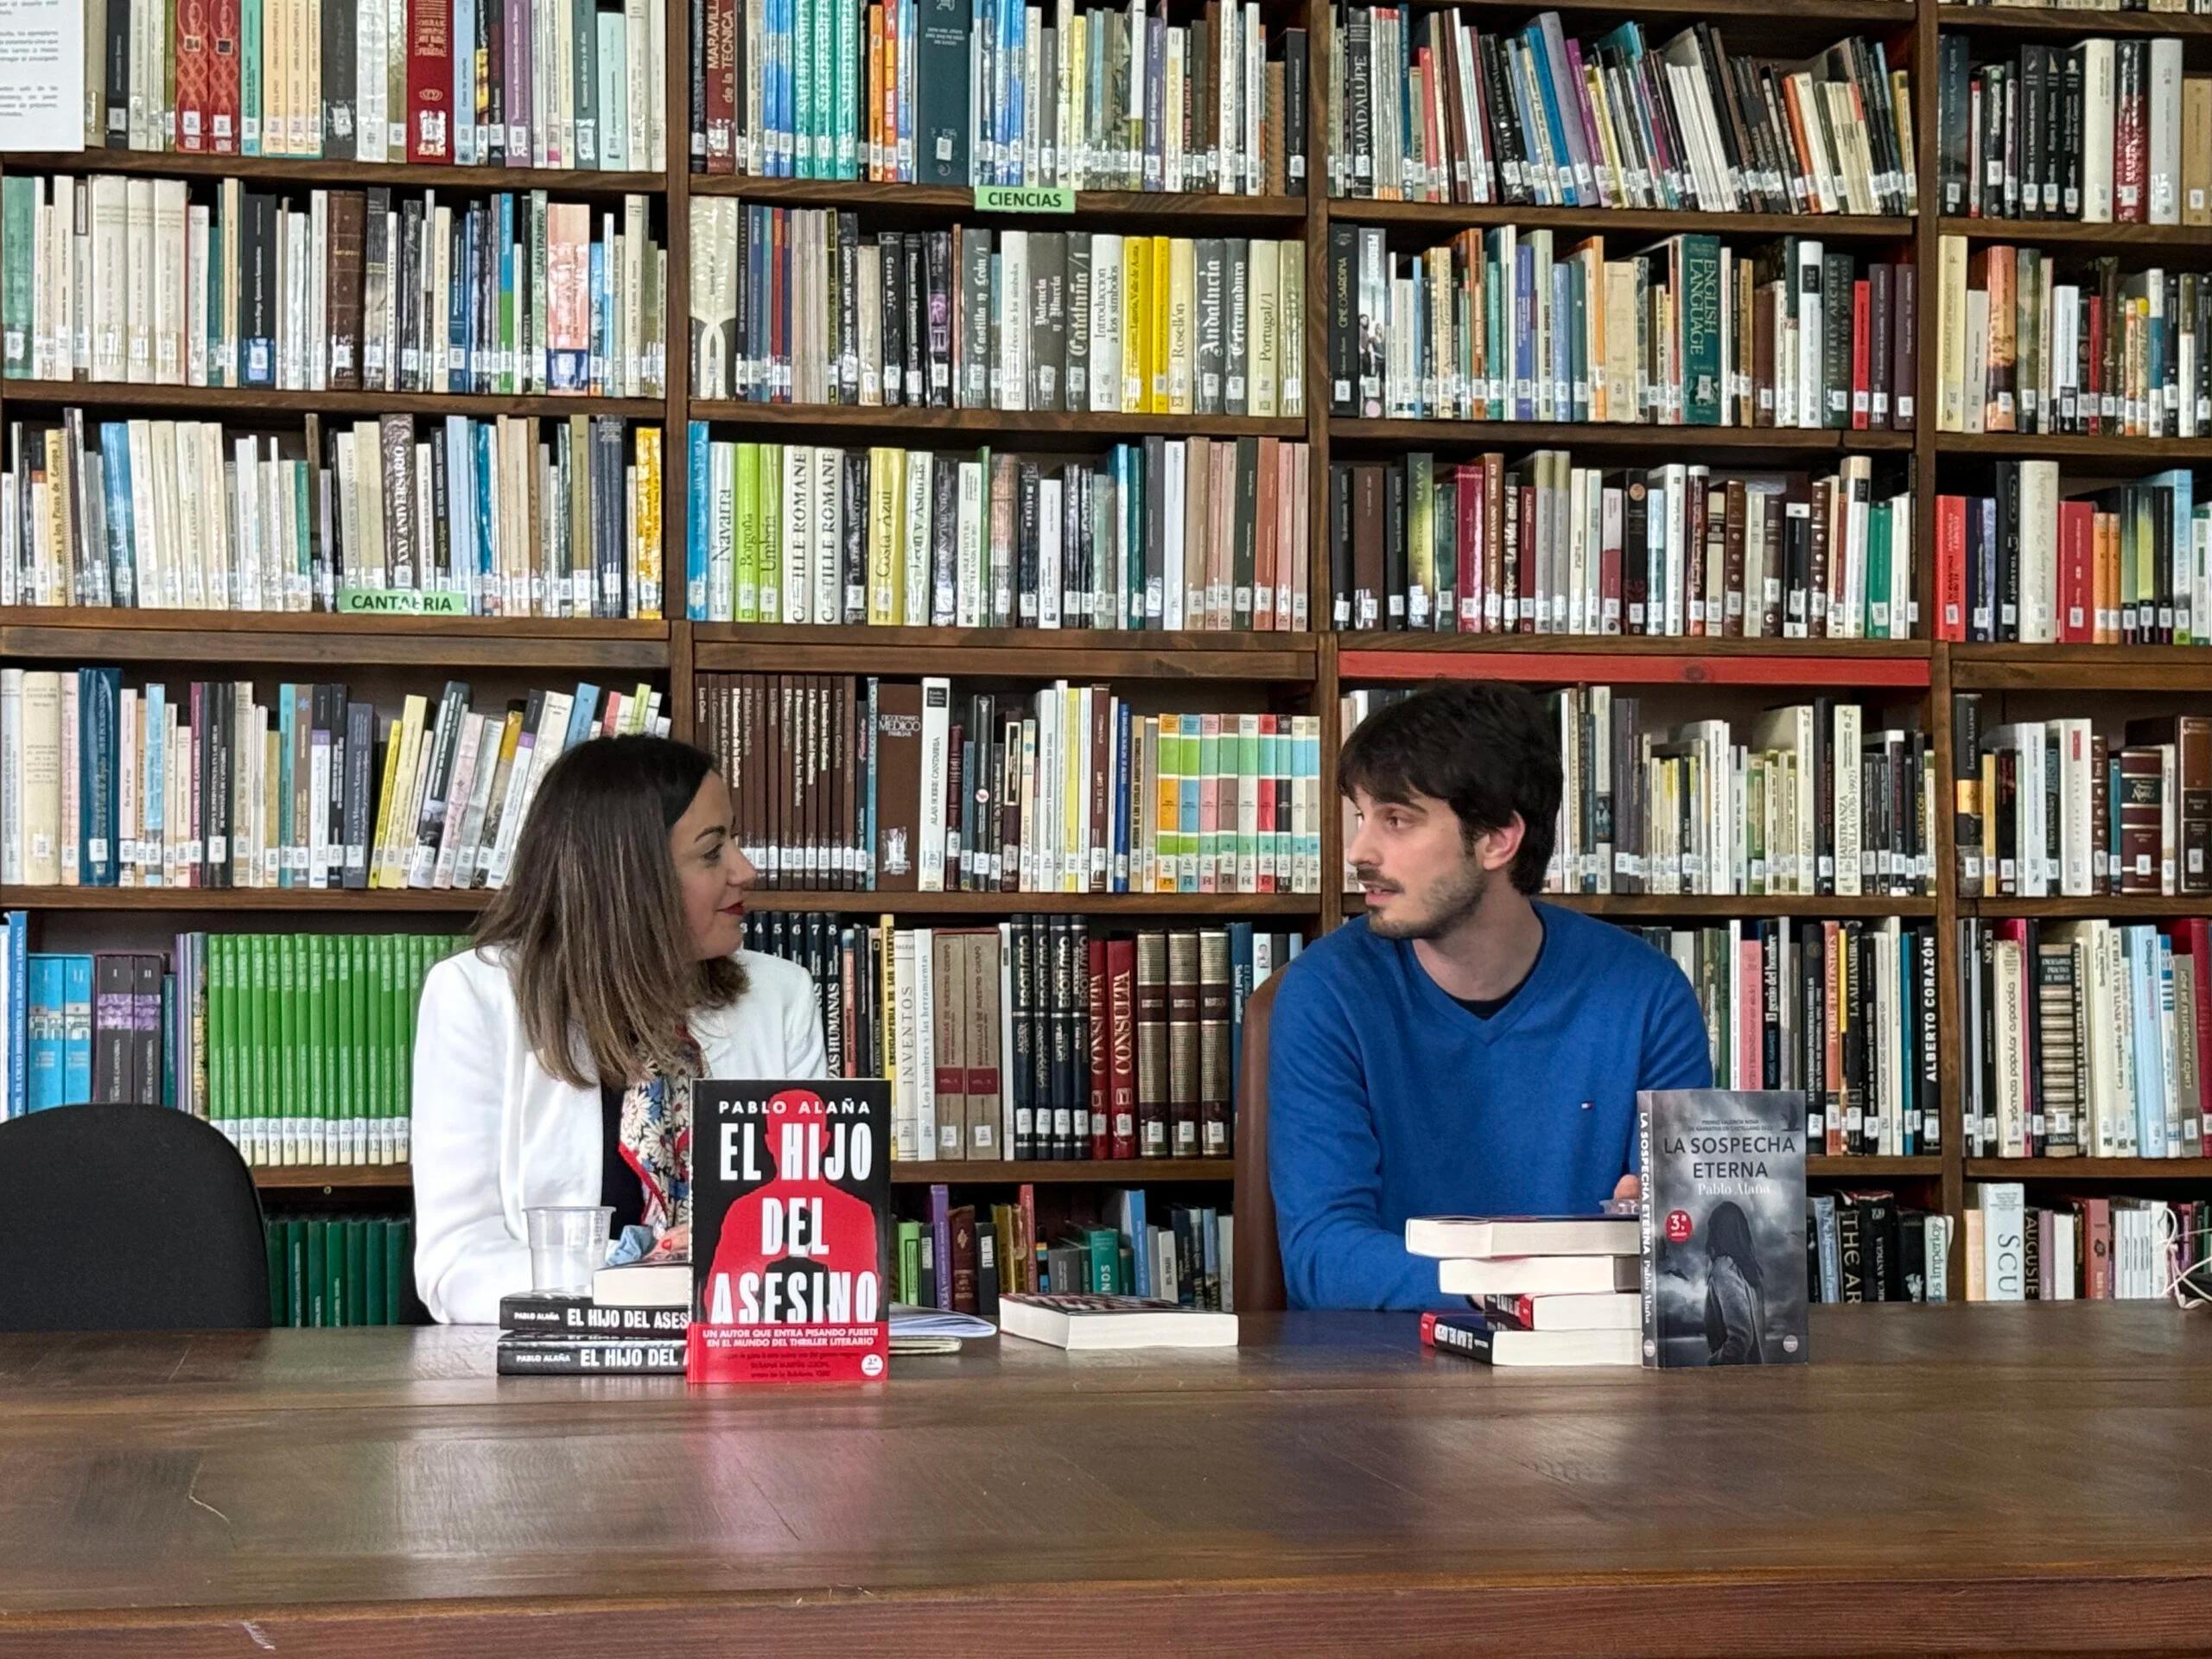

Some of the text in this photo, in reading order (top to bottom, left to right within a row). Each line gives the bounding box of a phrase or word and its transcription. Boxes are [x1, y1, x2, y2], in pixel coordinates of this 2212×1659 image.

[721, 10, 734, 103] de la TECNICA
[1353, 55, 1369, 156] GUADALUPE
[987, 191, 1063, 208] CIENCIAS
[887, 257, 895, 307] Greek Art
[910, 283, 918, 298] and
[1050, 276, 1063, 316] Murcia
[1338, 257, 1348, 297] SARDINA
[1704, 259, 1717, 334] ENGLISH
[1034, 279, 1049, 326] Valencia
[1094, 268, 1109, 339] Introducción
[1107, 316, 1120, 333] los
[1199, 260, 1223, 356] Andalucía
[1230, 262, 1245, 356] Extremadura
[1338, 307, 1348, 327] CINE
[1689, 258, 1703, 354] LANGUAGE
[1827, 260, 1838, 380] JEFFREY ARCHER
[973, 307, 988, 354] Castilla
[1171, 303, 1186, 358] Rosellón
[50, 449, 60, 493] de Europa
[393, 447, 408, 535] ANIVERSARIO
[1414, 461, 1424, 500] MAYA
[52, 497, 60, 518] Picos
[711, 489, 732, 563] Navarra
[1505, 498, 1517, 520] ante
[740, 513, 755, 566] Borgoña
[792, 454, 806, 622] CAILLE ROMANE
[822, 454, 836, 622] CATILLE ROMANE
[874, 535, 891, 577] Costa
[1505, 523, 1517, 544] vida
[931, 737, 939, 779] CANTABRIA
[739, 923, 747, 935] 3
[755, 923, 764, 935] 4
[773, 923, 783, 935] 5
[791, 923, 801, 935] 6
[811, 923, 821, 935] 7
[828, 923, 837, 935] 8
[1765, 934, 1778, 969] hombre
[887, 971, 895, 986] LOS
[1765, 971, 1778, 985] del
[1828, 935, 1838, 985] LONDRES
[1848, 935, 1859, 1016] LA ALHAMBRA
[887, 992, 895, 1002] DE
[921, 956, 931, 1017] herramientas
[1765, 986, 1778, 1011] genio
[1922, 937, 1937, 1081] ALBERTO CORAZÓN
[827, 982, 841, 1052] HUMANAS
[887, 1007, 895, 1065] ENCICLOPEDIA
[901, 986, 914, 1085] INVENTOS
[921, 1020, 931, 1033] las
[1090, 973, 1104, 1074] CONSULTA
[1113, 970, 1132, 1074] CONSULTA
[1828, 1006, 1838, 1045] TORRE
[921, 1046, 931, 1088] hombres
[2006, 982, 2018, 1123] erámica popular española
[719, 1097, 871, 1114] PABLO ALAÑA
[921, 1091, 931, 1109] Los
[721, 1122, 872, 1181] EL HIJO
[1640, 1113, 1649, 1201] LA SOSPECHA
[1664, 1136, 1796, 1154] LA SOSPECHA
[1694, 1161, 1768, 1179] ETERNA
[1699, 1181, 1770, 1196] Pablo Alaña
[761, 1197, 830, 1255] DEL
[1842, 1214, 1860, 1265] THE
[1642, 1204, 1652, 1324] ETERNA Pablo Alaña
[1876, 1237, 1885, 1300] RICA ANTIGUA
[1997, 1234, 2020, 1293] SCU
[2024, 1216, 2037, 1294] AUGUSTE
[537, 1312, 560, 1320] ALAÑA
[567, 1308, 584, 1326] EL
[588, 1309, 620, 1327] HIJO
[624, 1310, 650, 1329] DEL
[710, 1272, 877, 1324] ASESINO
[702, 1330, 717, 1338] UN
[719, 1330, 750, 1338] AUTOR
[753, 1329, 771, 1338] QUE
[805, 1328, 845, 1337] PISANDO
[848, 1327, 879, 1336] FUERTE
[772, 1338, 788, 1347] DEL
[830, 1338, 874, 1346] LITERARIO
[543, 1353, 571, 1362] ALAÑA
[580, 1349, 600, 1367] EL
[605, 1349, 643, 1366] HIJO
[648, 1349, 678, 1365] DEL
